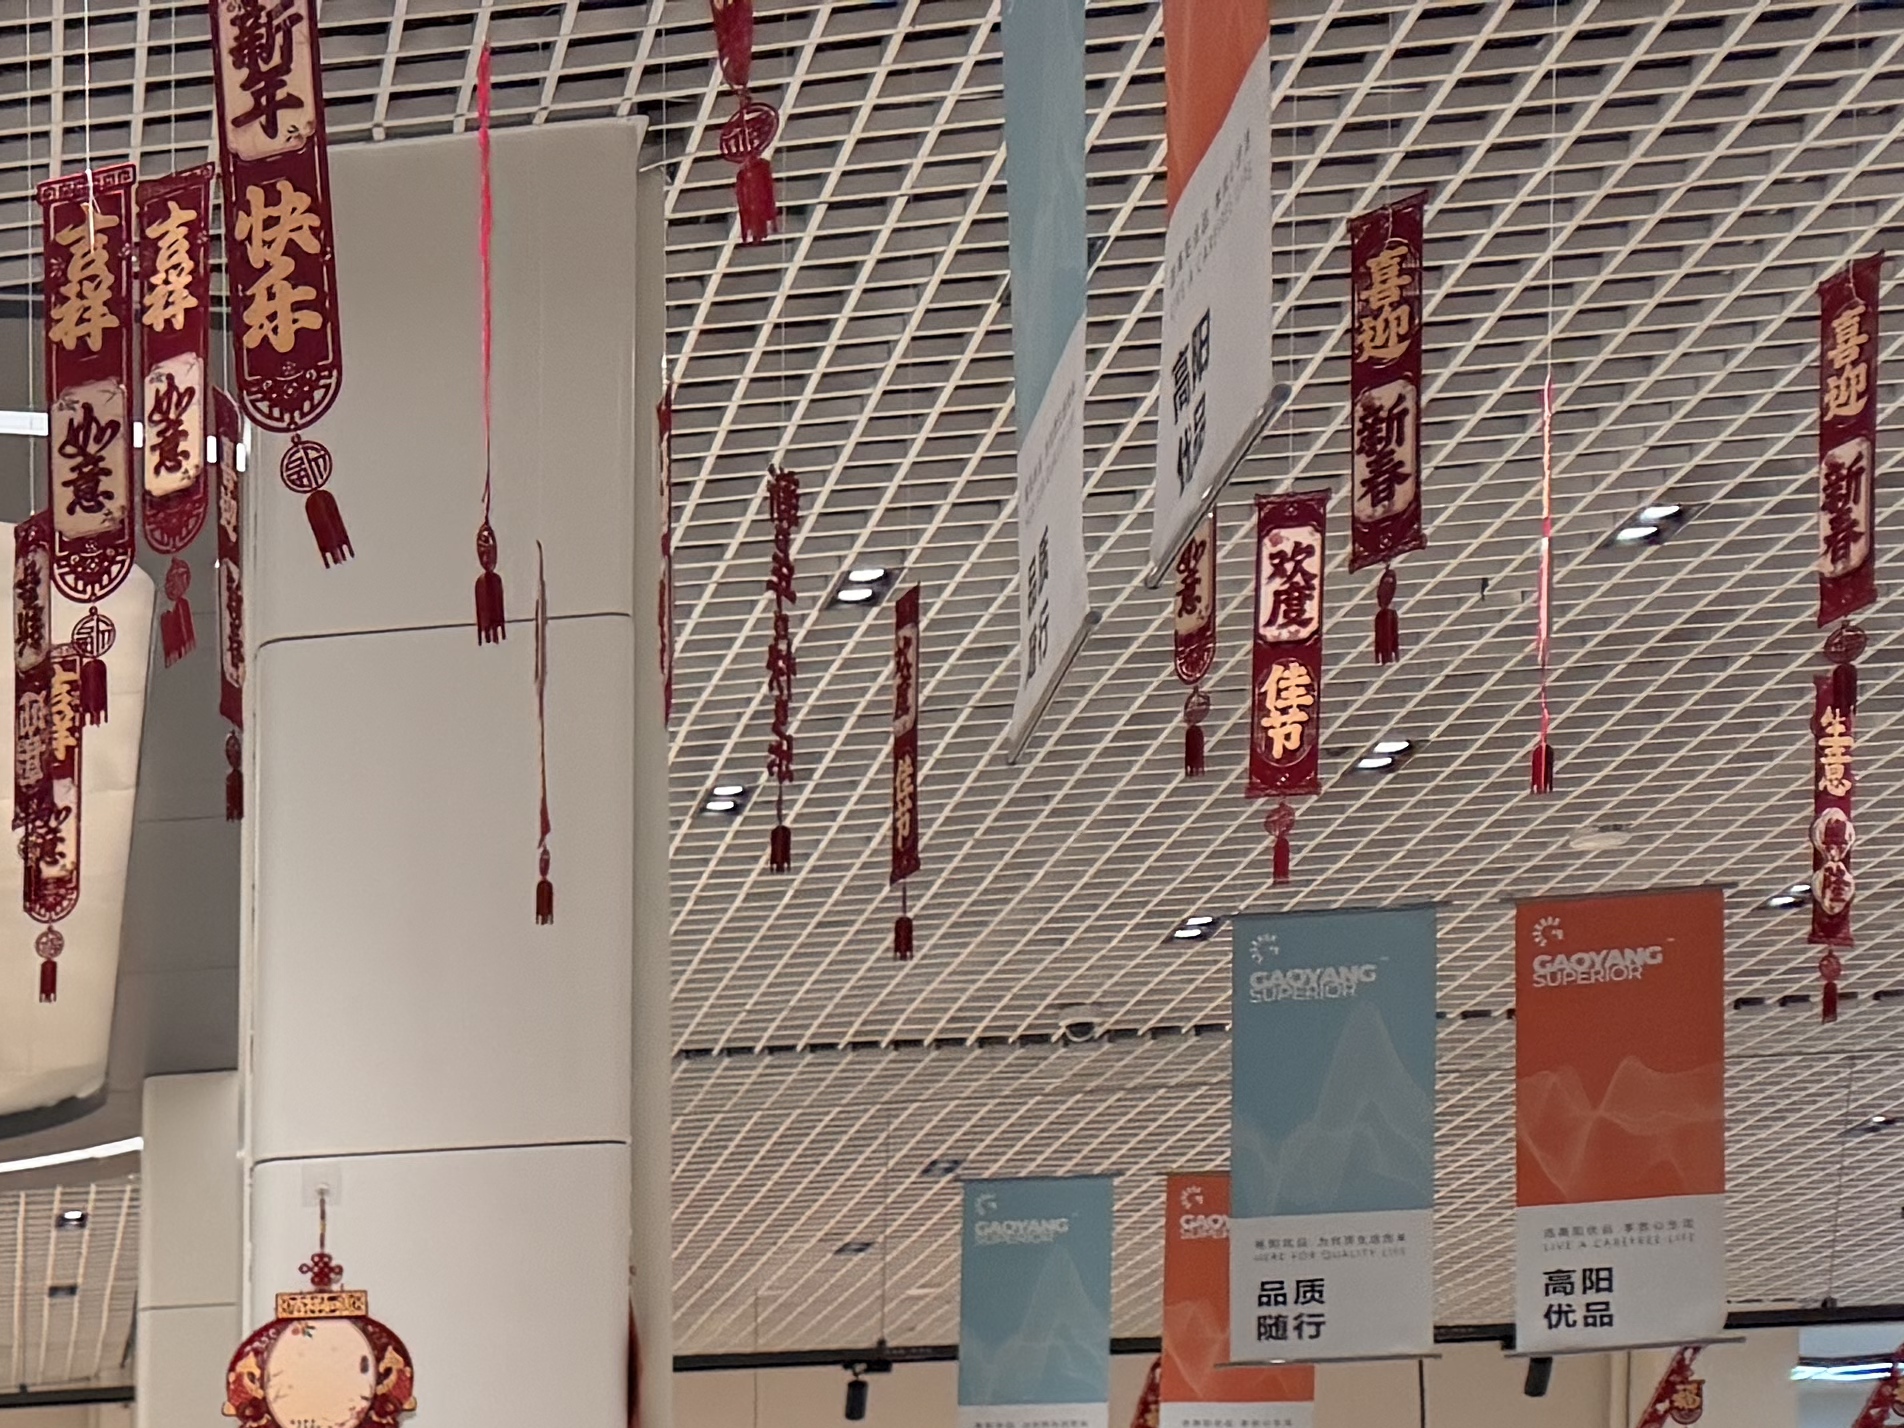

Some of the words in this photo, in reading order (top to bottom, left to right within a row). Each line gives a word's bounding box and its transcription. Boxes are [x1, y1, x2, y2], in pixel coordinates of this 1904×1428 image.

[230, 2, 323, 353] 新年快乐
[141, 200, 198, 479] 吉祥如意
[49, 202, 121, 515] 吉祥如意
[1355, 248, 1413, 509] 喜迎新春
[1821, 306, 1869, 573] 喜迎新春
[1259, 540, 1319, 760] 欢度佳节
[1532, 945, 1663, 972] GAOYANG
[1249, 964, 1377, 990] GAOYANG
[1533, 964, 1643, 988] SUPERIOR
[1250, 981, 1358, 1003] SUPERIOR
[1257, 1277, 1327, 1307] 品质
[1543, 1267, 1614, 1297] 高阳
[1256, 1311, 1327, 1342] 随行
[1543, 1302, 1614, 1330] 优品
